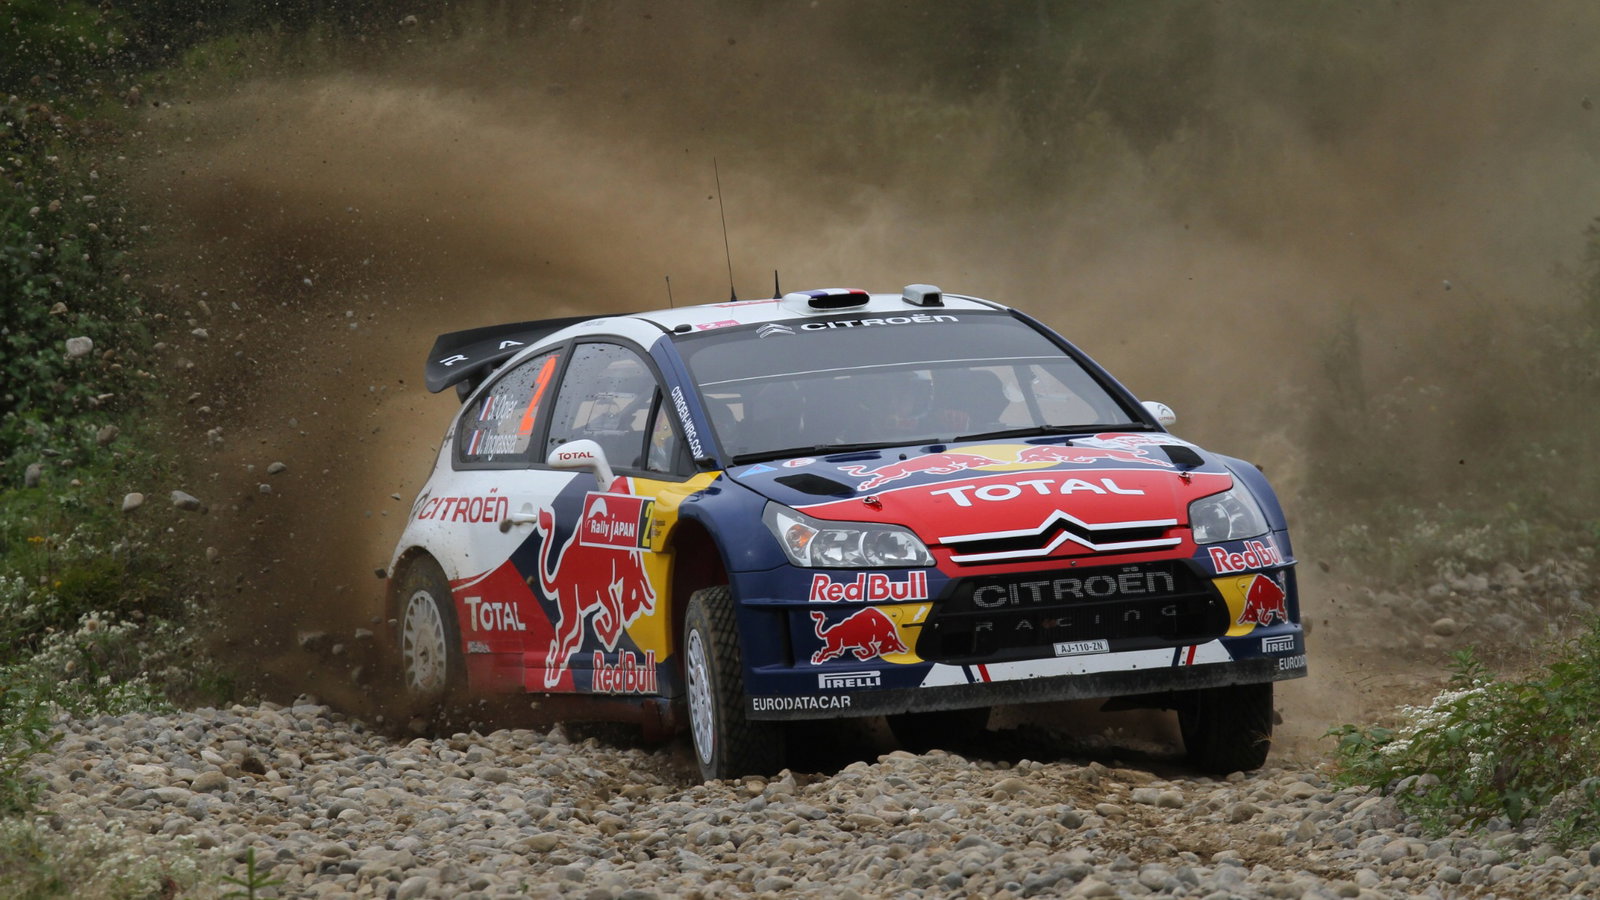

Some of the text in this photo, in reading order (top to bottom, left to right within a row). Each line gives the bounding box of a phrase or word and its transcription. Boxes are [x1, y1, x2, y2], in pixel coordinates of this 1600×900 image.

[800, 313, 960, 331] CITROËN
[558, 451, 595, 461] TOTAL
[417, 487, 509, 524] CITROËN
[930, 477, 1145, 507] TOTAL
[590, 519, 609, 537] Rally
[1207, 540, 1263, 574] Red
[809, 570, 929, 602] Red Bull
[973, 566, 1175, 608] CITROËN
[464, 596, 527, 632] TOTAL
[1261, 634, 1295, 653] PIRELLI
[592, 648, 658, 694] Red Bull
[818, 670, 881, 689] PIRELLI
[752, 695, 851, 711] EURODATACAR
